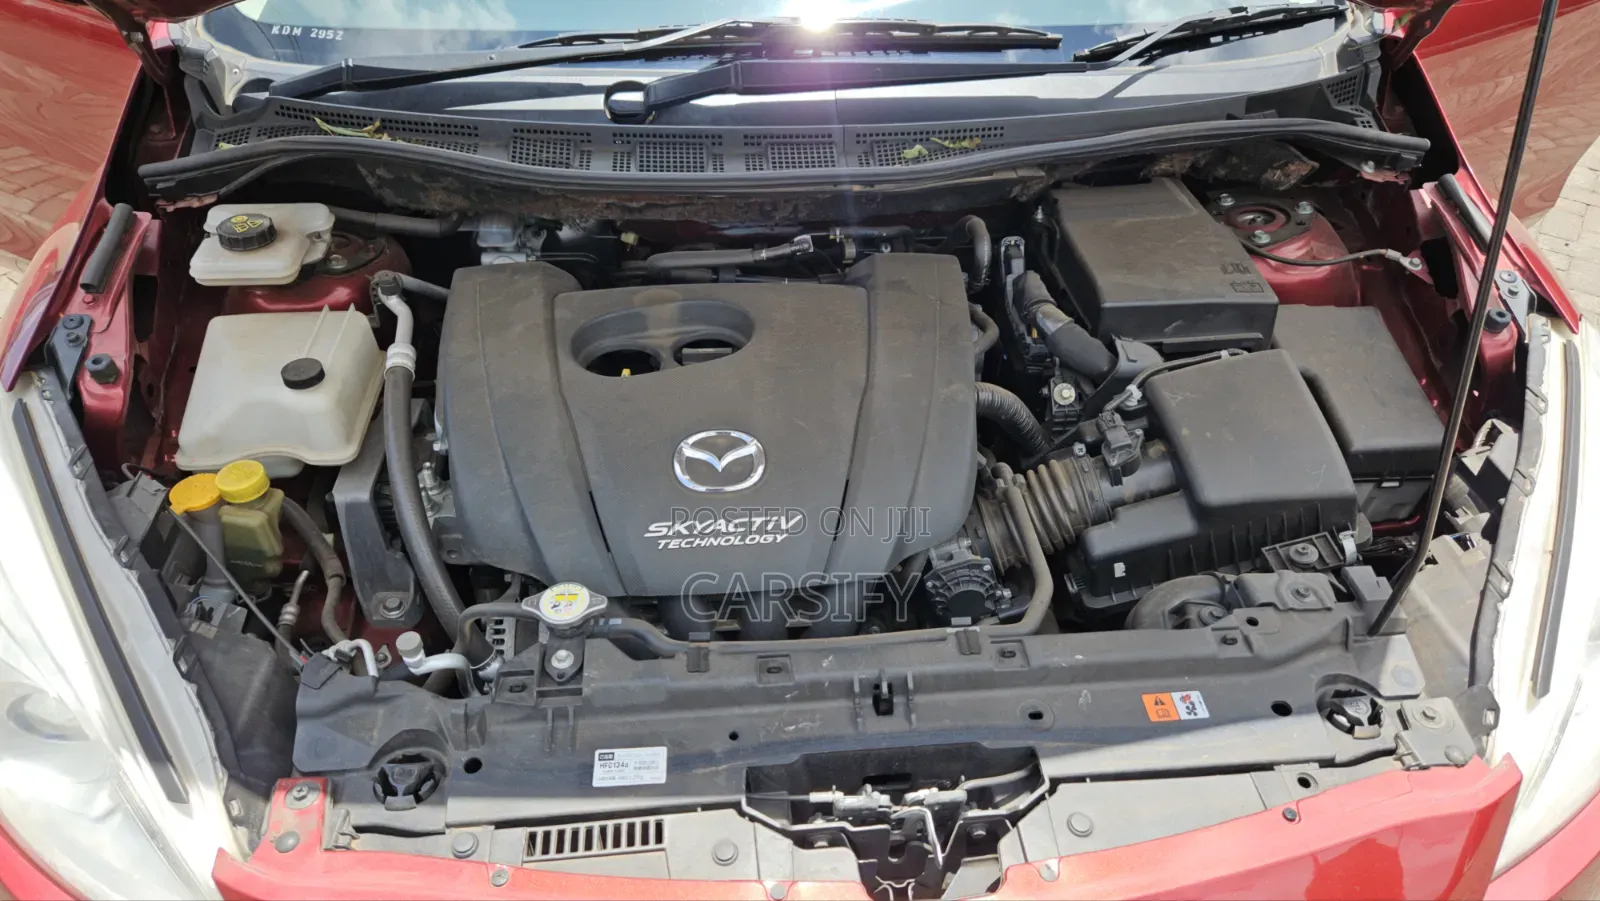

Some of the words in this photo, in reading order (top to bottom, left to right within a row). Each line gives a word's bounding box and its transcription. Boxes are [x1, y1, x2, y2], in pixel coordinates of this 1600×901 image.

[271, 25, 302, 36] KDM
[657, 533, 788, 550] TECHNOLOGY
[599, 761, 629, 769] HFC134a
